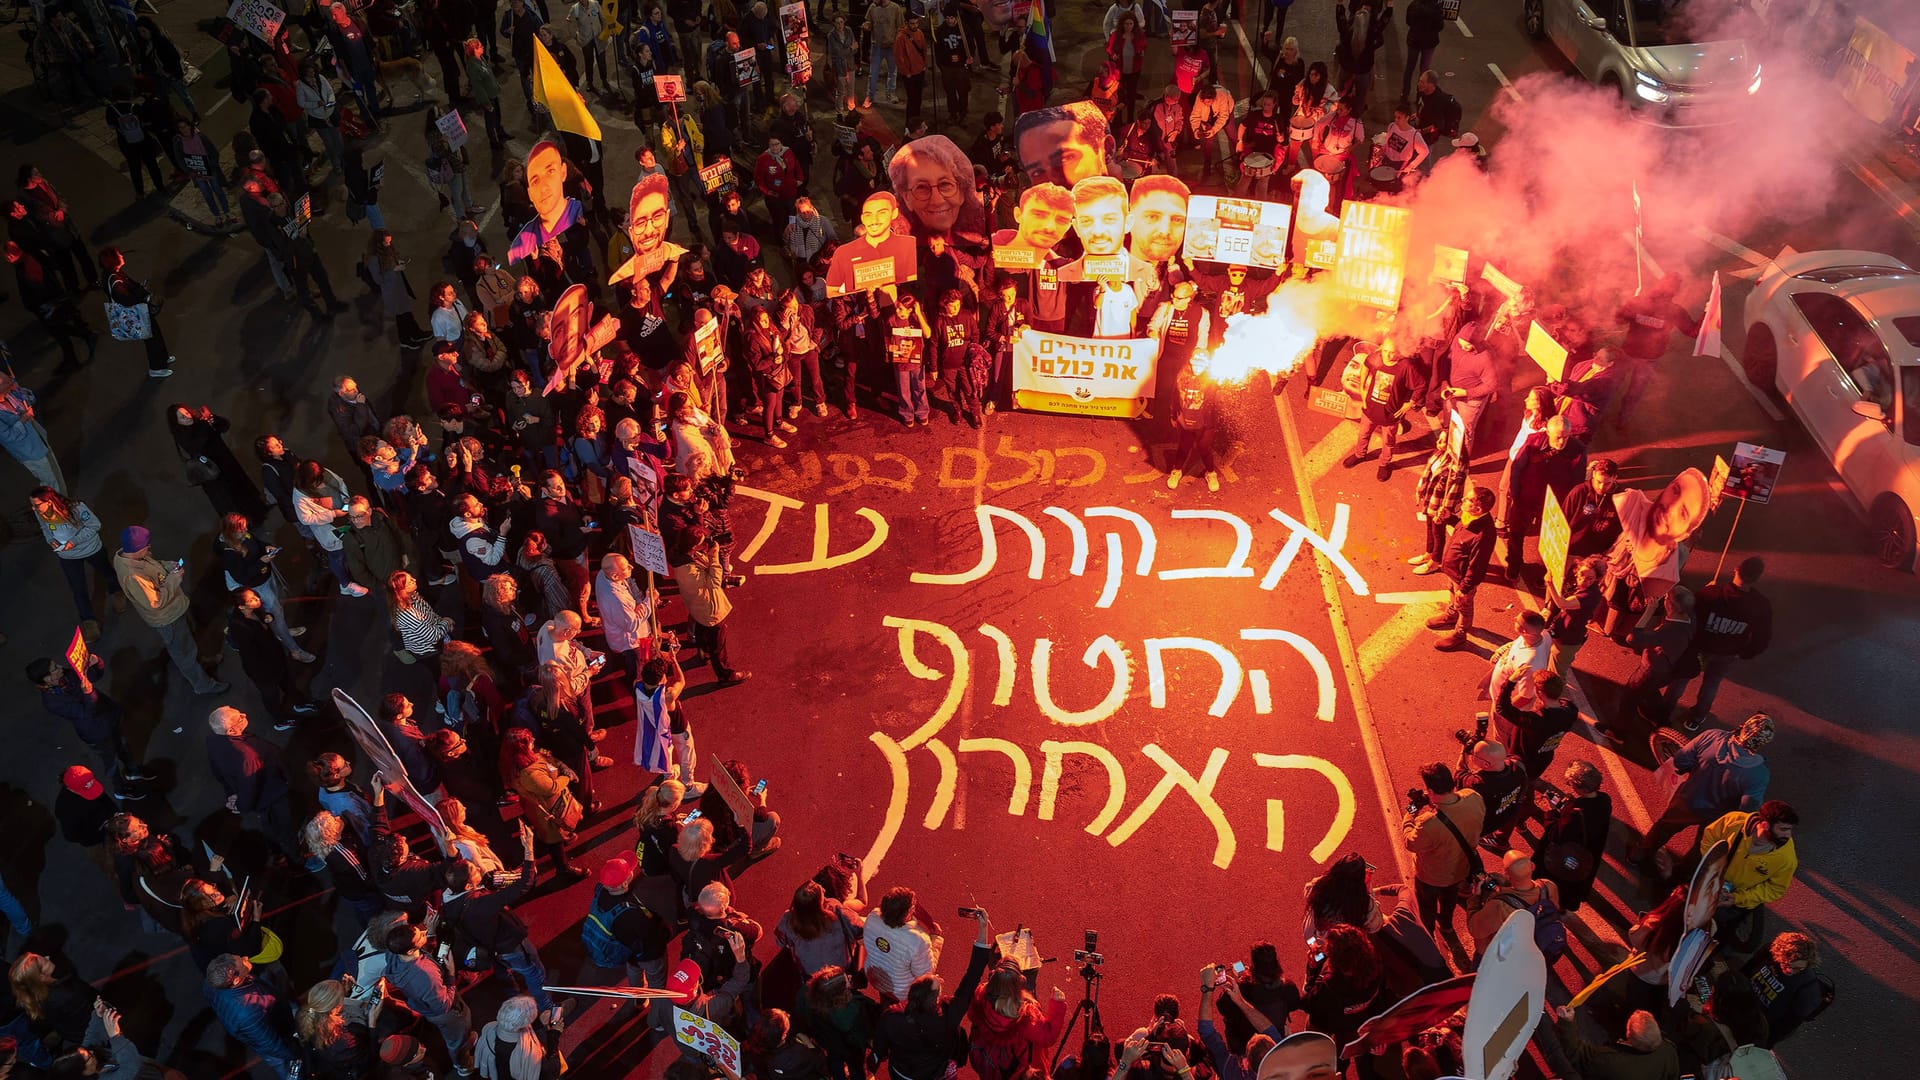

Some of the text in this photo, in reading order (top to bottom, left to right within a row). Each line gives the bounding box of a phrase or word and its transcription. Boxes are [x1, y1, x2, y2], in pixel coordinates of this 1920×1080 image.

[1344, 203, 1380, 231] ALL
[640, 316, 662, 338] adidas
[1040, 339, 1132, 360] מחזירים
[1032, 356, 1138, 380] את כולם!
[938, 435, 1107, 491] כולם
[735, 485, 889, 575] עד
[910, 503, 1370, 608] אבקות
[883, 616, 1337, 752] החטוף
[860, 731, 1357, 884] האחרון
